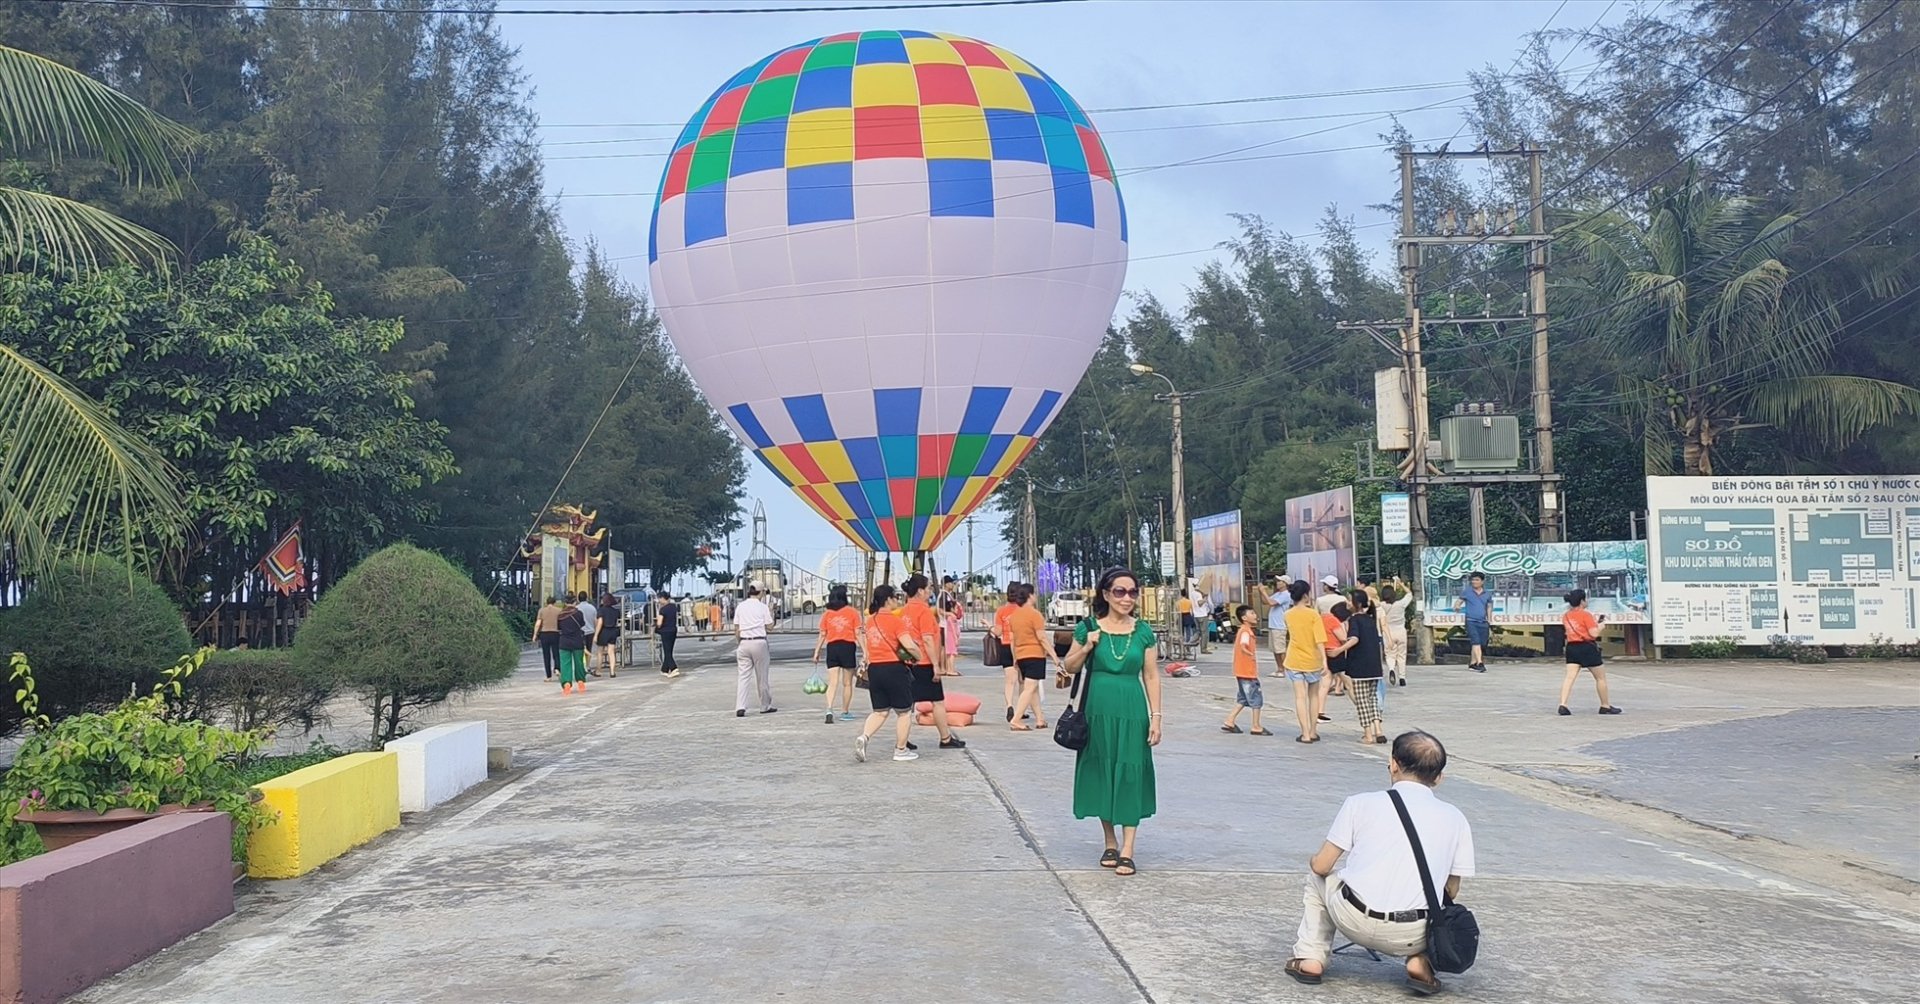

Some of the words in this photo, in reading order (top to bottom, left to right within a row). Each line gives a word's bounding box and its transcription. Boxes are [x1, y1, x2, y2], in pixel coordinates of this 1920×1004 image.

[1711, 477, 1737, 490] BIỂN
[1797, 476, 1820, 490] TẮM
[1823, 477, 1837, 490] SỐ
[1840, 481, 1845, 490] 1
[1848, 479, 1869, 490] CHÚ
[1872, 478, 1880, 490] Ý
[1882, 478, 1911, 490] NƯỚC
[1690, 494, 1710, 503] MỜI
[1712, 494, 1734, 504] QUÝ
[1738, 493, 1774, 504] KHÁCH
[1822, 491, 1845, 503] TẮM
[1847, 492, 1861, 503] SỐ
[1864, 495, 1872, 503] 2
[1873, 495, 1895, 503] SAU
[1690, 516, 1702, 525] LAO
[1685, 539, 1710, 551] SƠ
[1714, 535, 1742, 551] ĐỒ
[1428, 547, 1483, 580] Lá
[1481, 550, 1541, 576] Cọ
[1664, 556, 1680, 568] KHU
[1680, 556, 1692, 568] DU
[1692, 556, 1708, 571] LỊCH
[1708, 556, 1725, 568] SINH
[1725, 553, 1742, 568] THÁI
[1769, 593, 1777, 602] XE
[1430, 615, 1457, 624] KHU
[1513, 613, 1547, 622] SINH
[1615, 612, 1644, 622] ĐEN
[1839, 613, 1850, 624] TẠO
